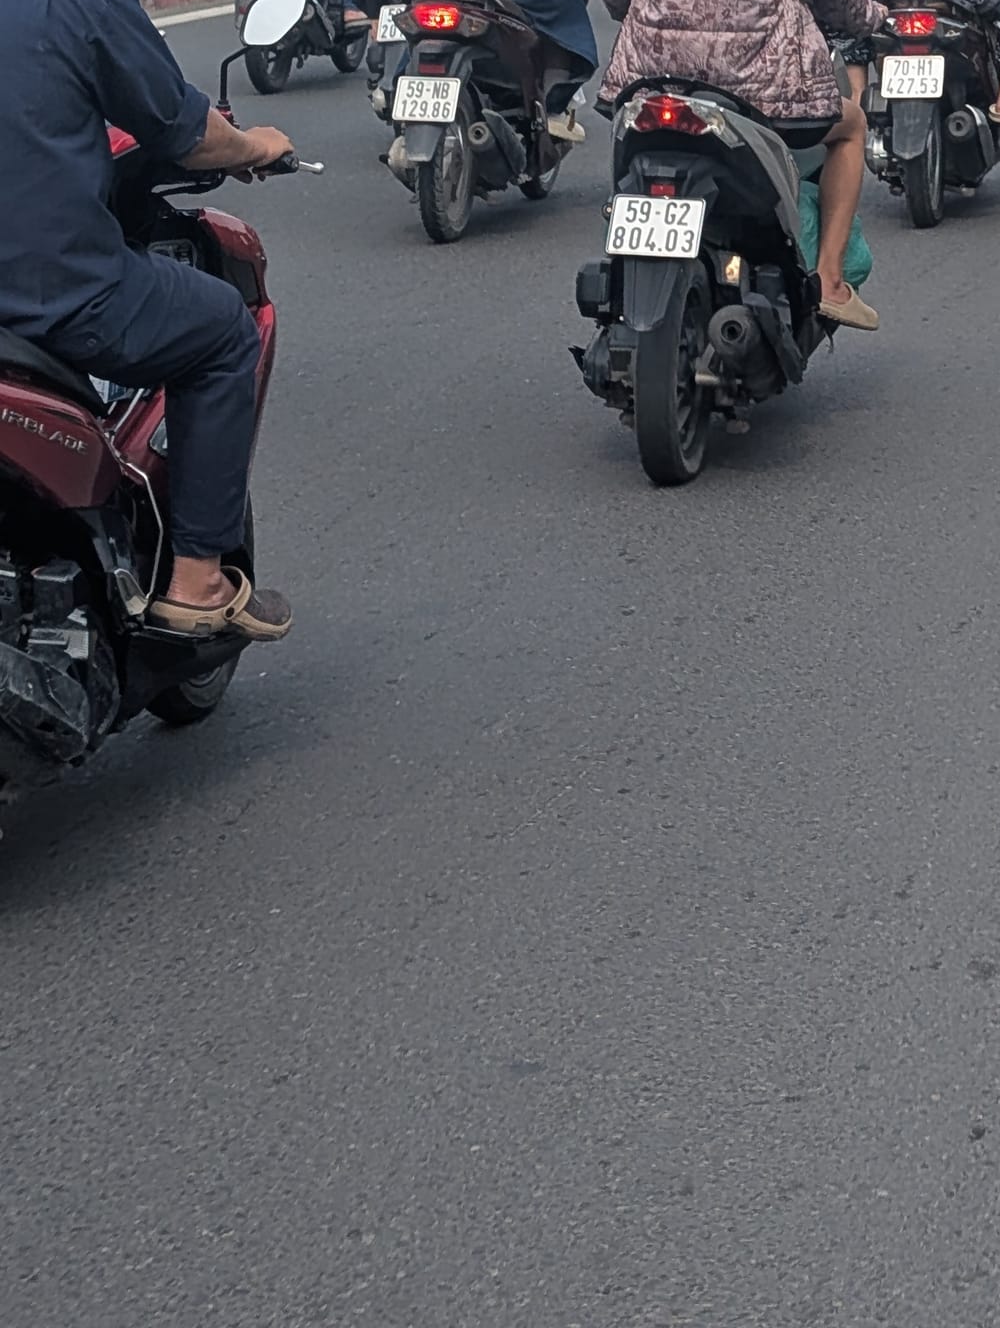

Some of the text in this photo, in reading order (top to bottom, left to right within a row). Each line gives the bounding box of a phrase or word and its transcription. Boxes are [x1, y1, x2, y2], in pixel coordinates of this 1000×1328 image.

[893, 59, 932, 76] 70-H1
[406, 81, 450, 100] 59-NB
[886, 77, 939, 95] 427.53
[401, 100, 451, 119] 129.86
[625, 199, 691, 227] 59-G2
[612, 226, 695, 253] 804.03
